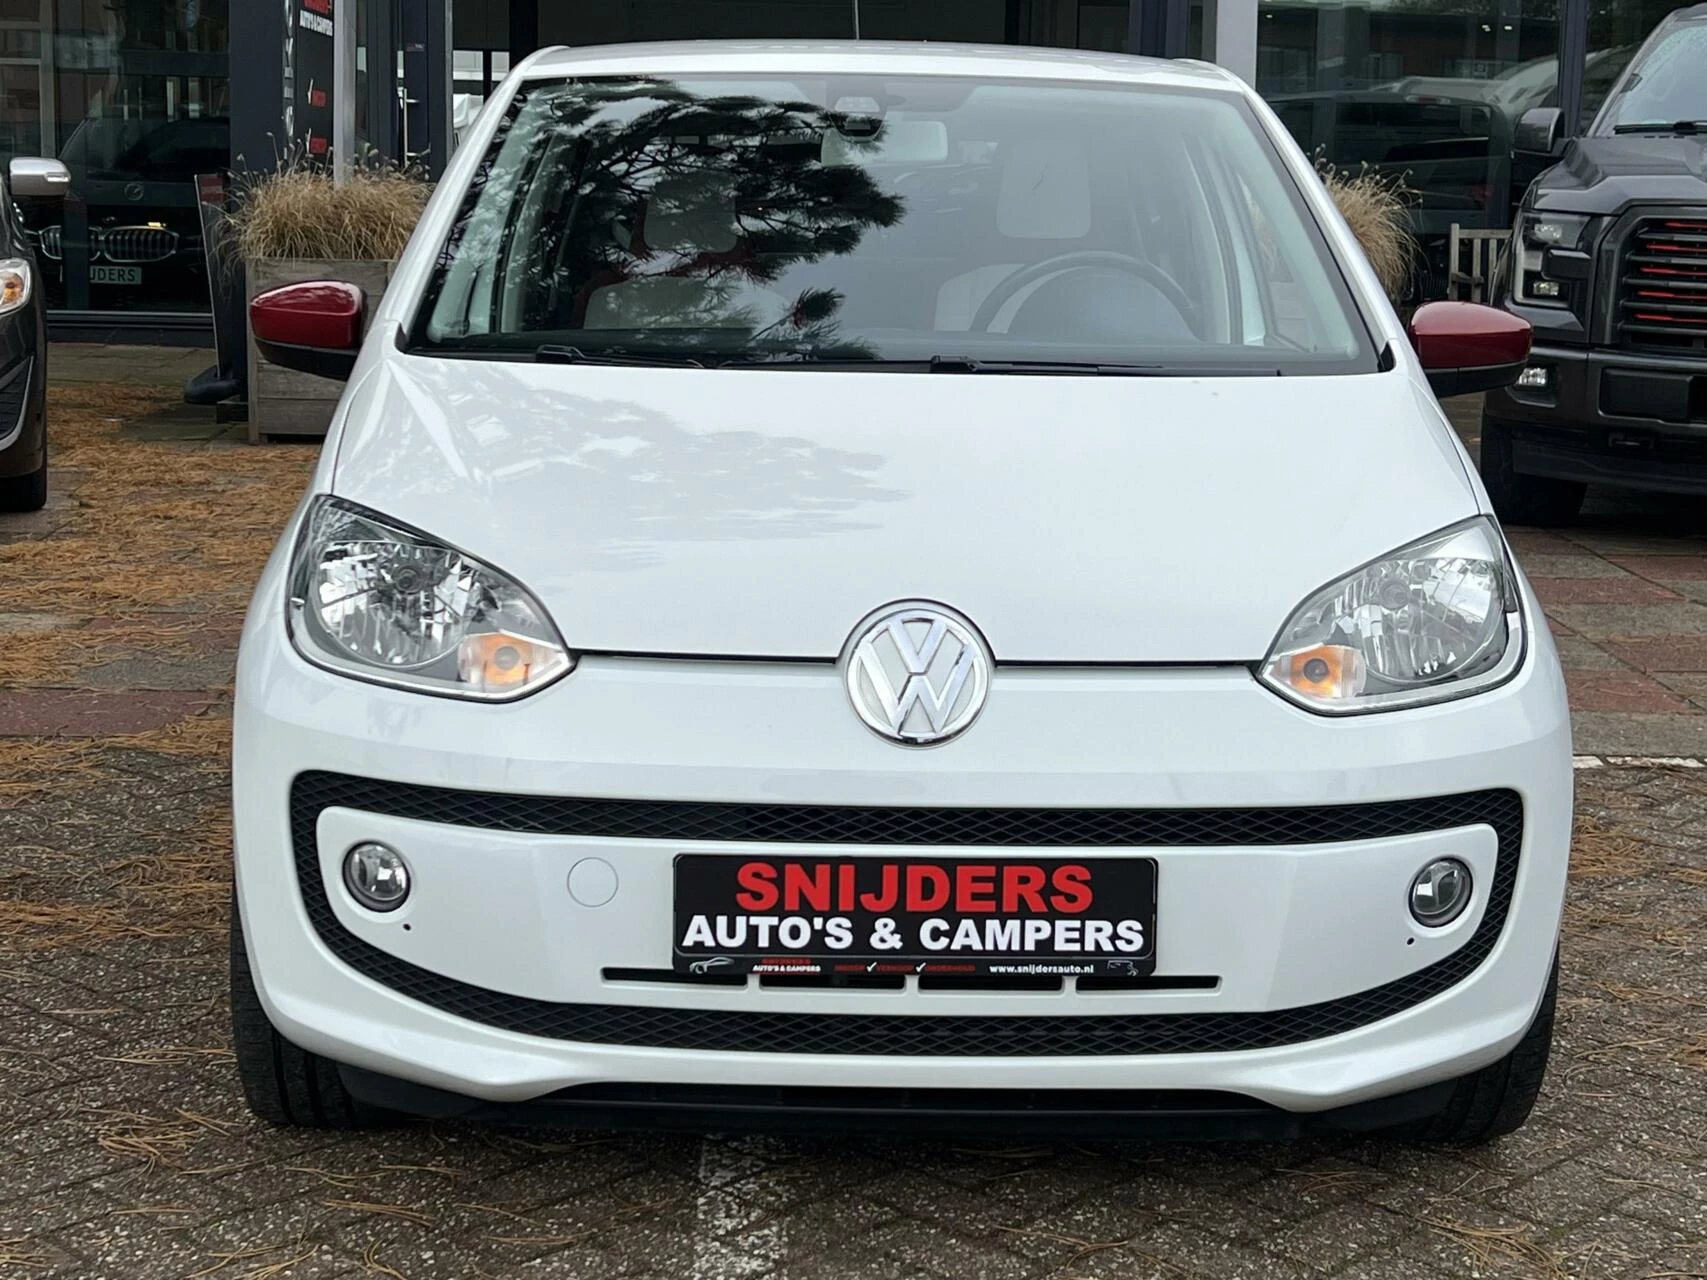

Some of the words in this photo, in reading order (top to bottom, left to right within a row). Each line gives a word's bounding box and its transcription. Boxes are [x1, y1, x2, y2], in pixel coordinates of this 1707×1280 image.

[735, 861, 1094, 914] SNIJDERS
[681, 914, 853, 950] AUTO'S
[869, 917, 903, 951] &
[919, 917, 1144, 952] CAMPERS
[989, 964, 1094, 975] www.snijdersauto.nl
